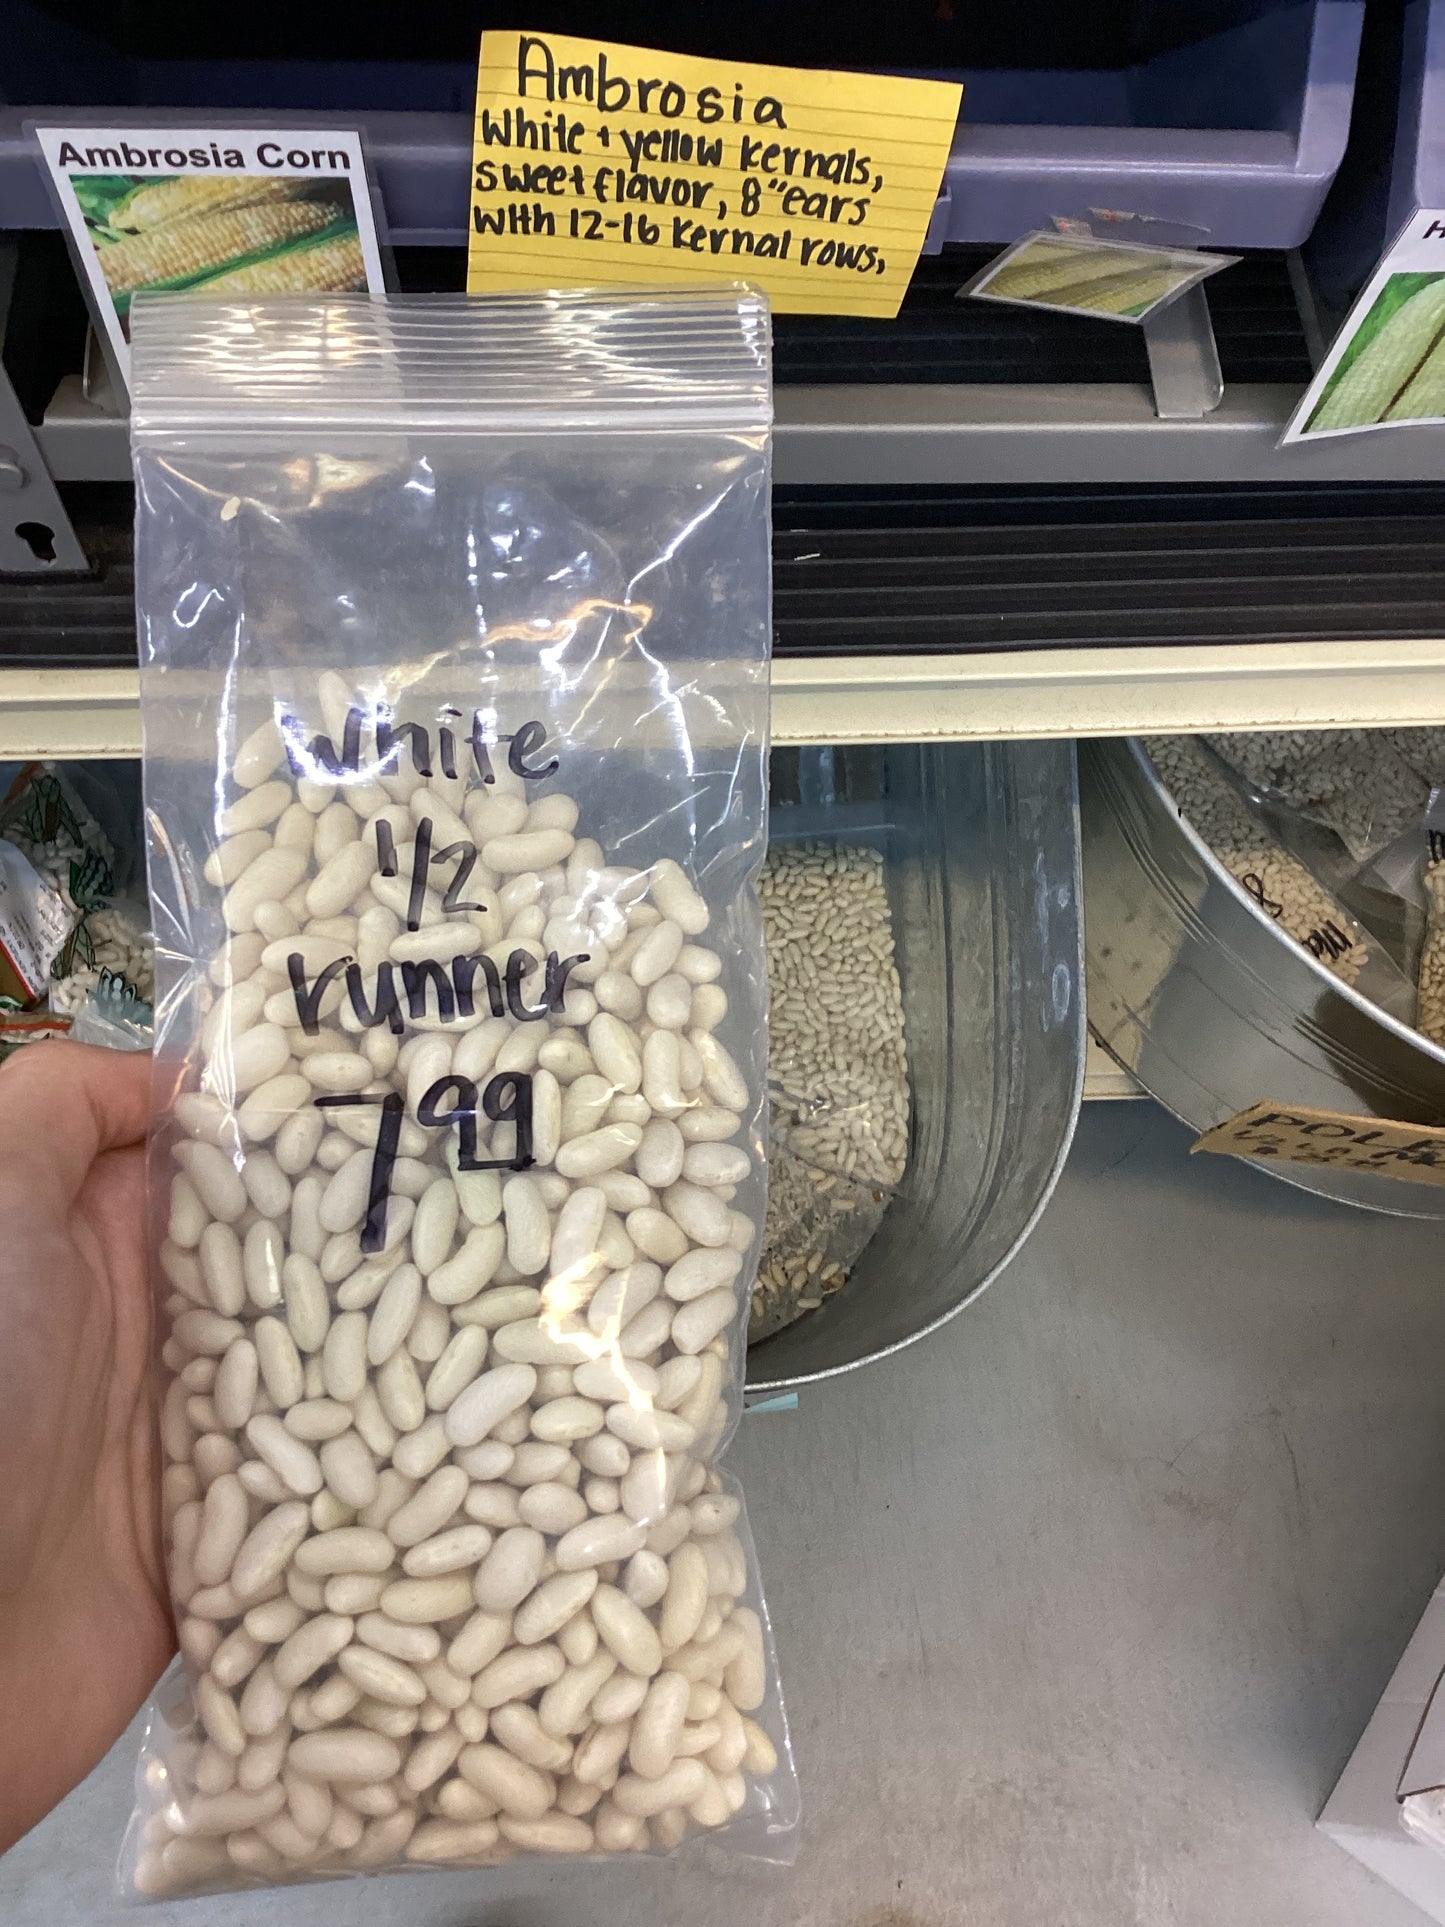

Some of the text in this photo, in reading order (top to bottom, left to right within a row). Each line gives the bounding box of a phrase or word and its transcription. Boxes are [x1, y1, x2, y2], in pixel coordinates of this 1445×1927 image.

[517, 35, 788, 130] Ambrosia
[58, 141, 351, 169] Ambrosia Corn
[482, 106, 586, 155] White
[619, 128, 724, 173] yellow
[475, 159, 586, 196] sweet
[593, 165, 728, 220] flavor,
[570, 207, 661, 245] 12-16
[800, 236, 886, 275] rows,
[375, 816, 488, 932] 1/2
[287, 948, 591, 1036] runner
